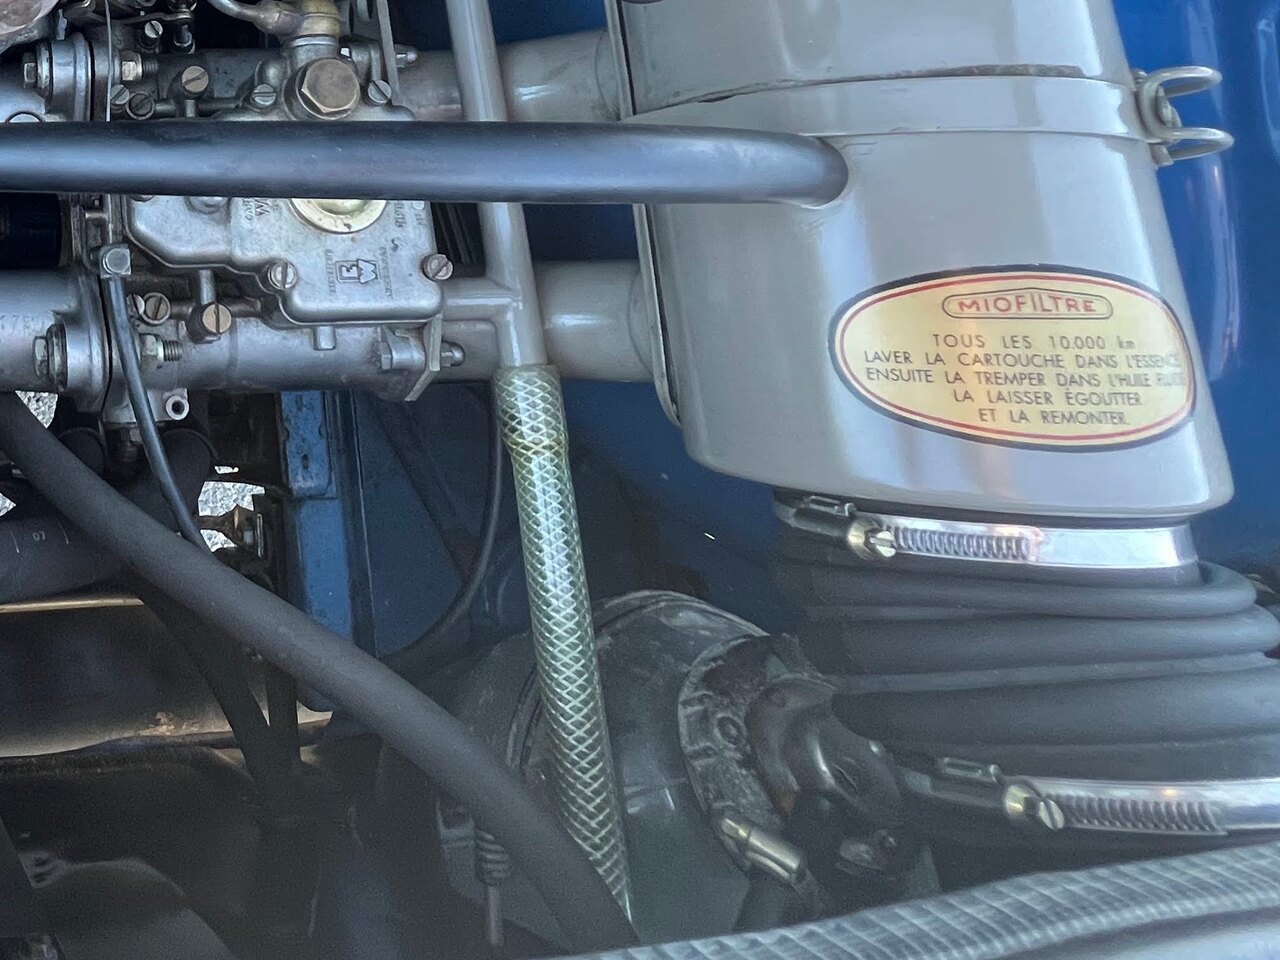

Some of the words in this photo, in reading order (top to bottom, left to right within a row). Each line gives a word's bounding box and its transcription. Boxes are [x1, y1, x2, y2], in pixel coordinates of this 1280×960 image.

[957, 292, 1097, 314] MIOFILTRE
[932, 333, 986, 349] TOUS
[1002, 334, 1033, 350] LES
[1048, 334, 1107, 350] 10.000
[864, 349, 913, 365] LAVER
[925, 351, 946, 366] LA
[957, 352, 1065, 369] CARTOUCHE
[1075, 354, 1118, 369] DANS
[865, 367, 935, 384] ENSUITE
[946, 369, 966, 385] LA
[976, 371, 1046, 387] TREMPER
[1057, 372, 1101, 388] DANS
[954, 388, 975, 404] LA
[987, 390, 1054, 406] LAISSER
[1066, 387, 1142, 407] ÉGOUTTER
[979, 407, 997, 423] ET
[1009, 408, 1030, 424] LA
[1042, 410, 1128, 426] REMONTER
